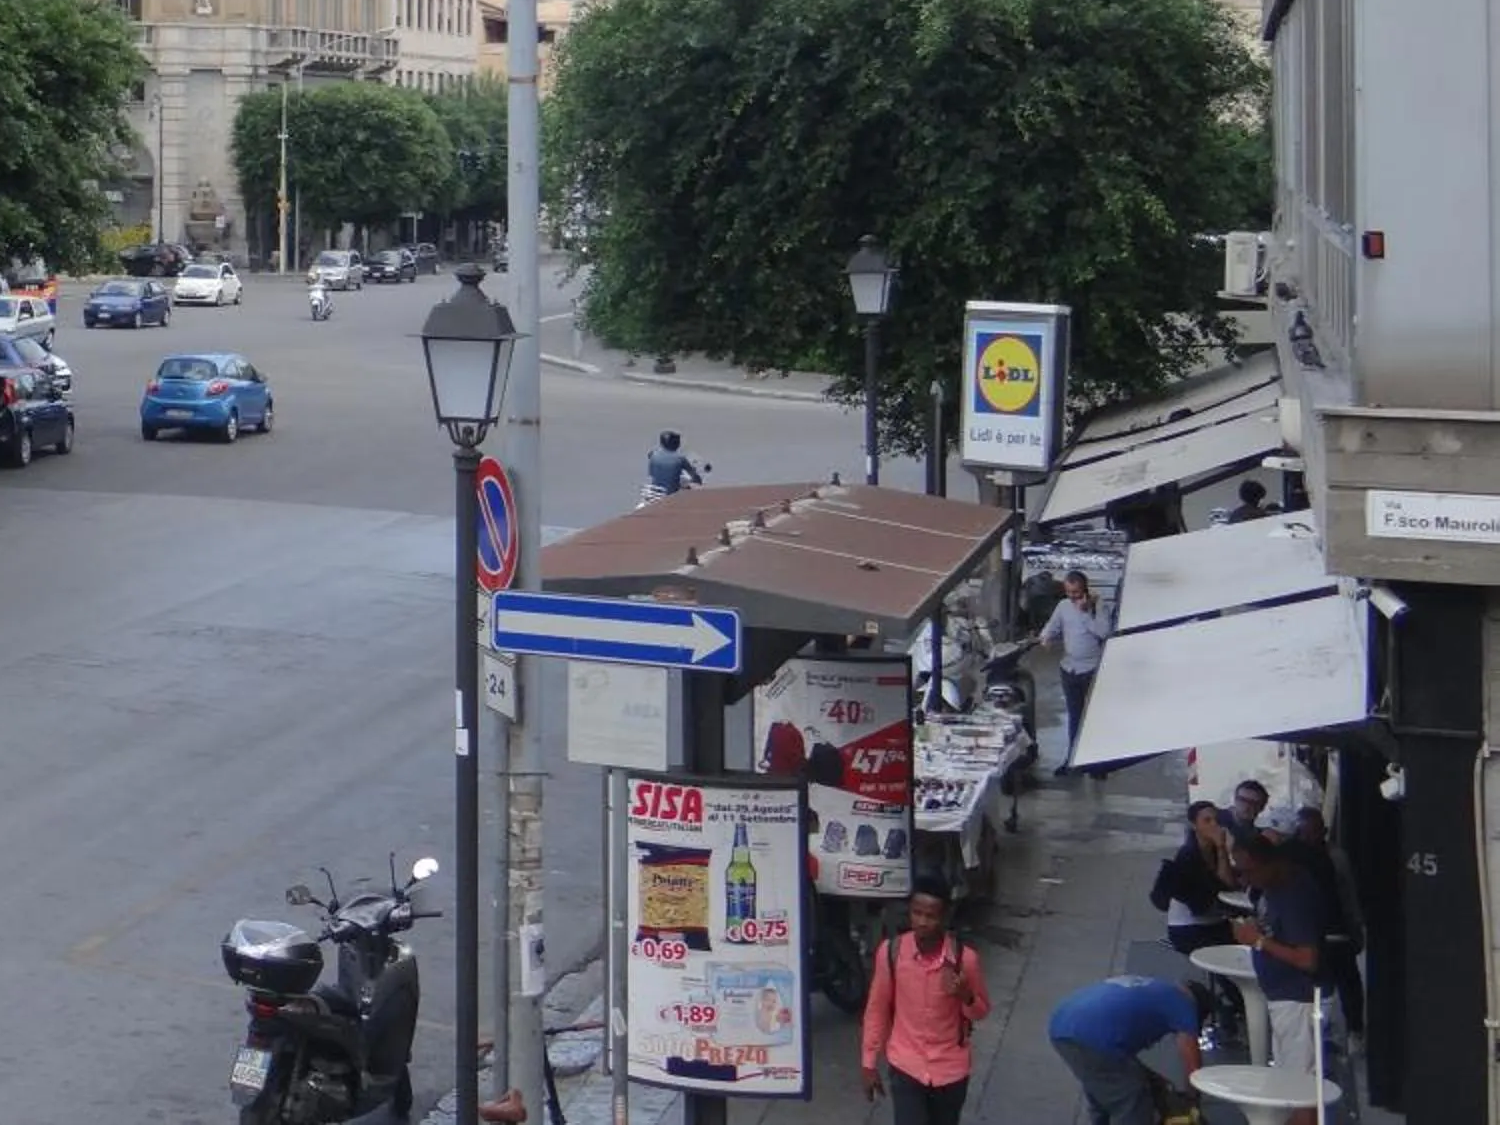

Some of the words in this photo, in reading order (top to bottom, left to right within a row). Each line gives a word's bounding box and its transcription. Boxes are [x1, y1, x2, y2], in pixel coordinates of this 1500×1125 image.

[969, 429, 992, 442] Lidl
[1007, 434, 1025, 446] per
[631, 782, 703, 823] SISA
[1406, 851, 1437, 876] 45
[744, 919, 787, 940] 0,75
[643, 939, 687, 963] 0,69
[672, 1004, 716, 1025] 1,89
